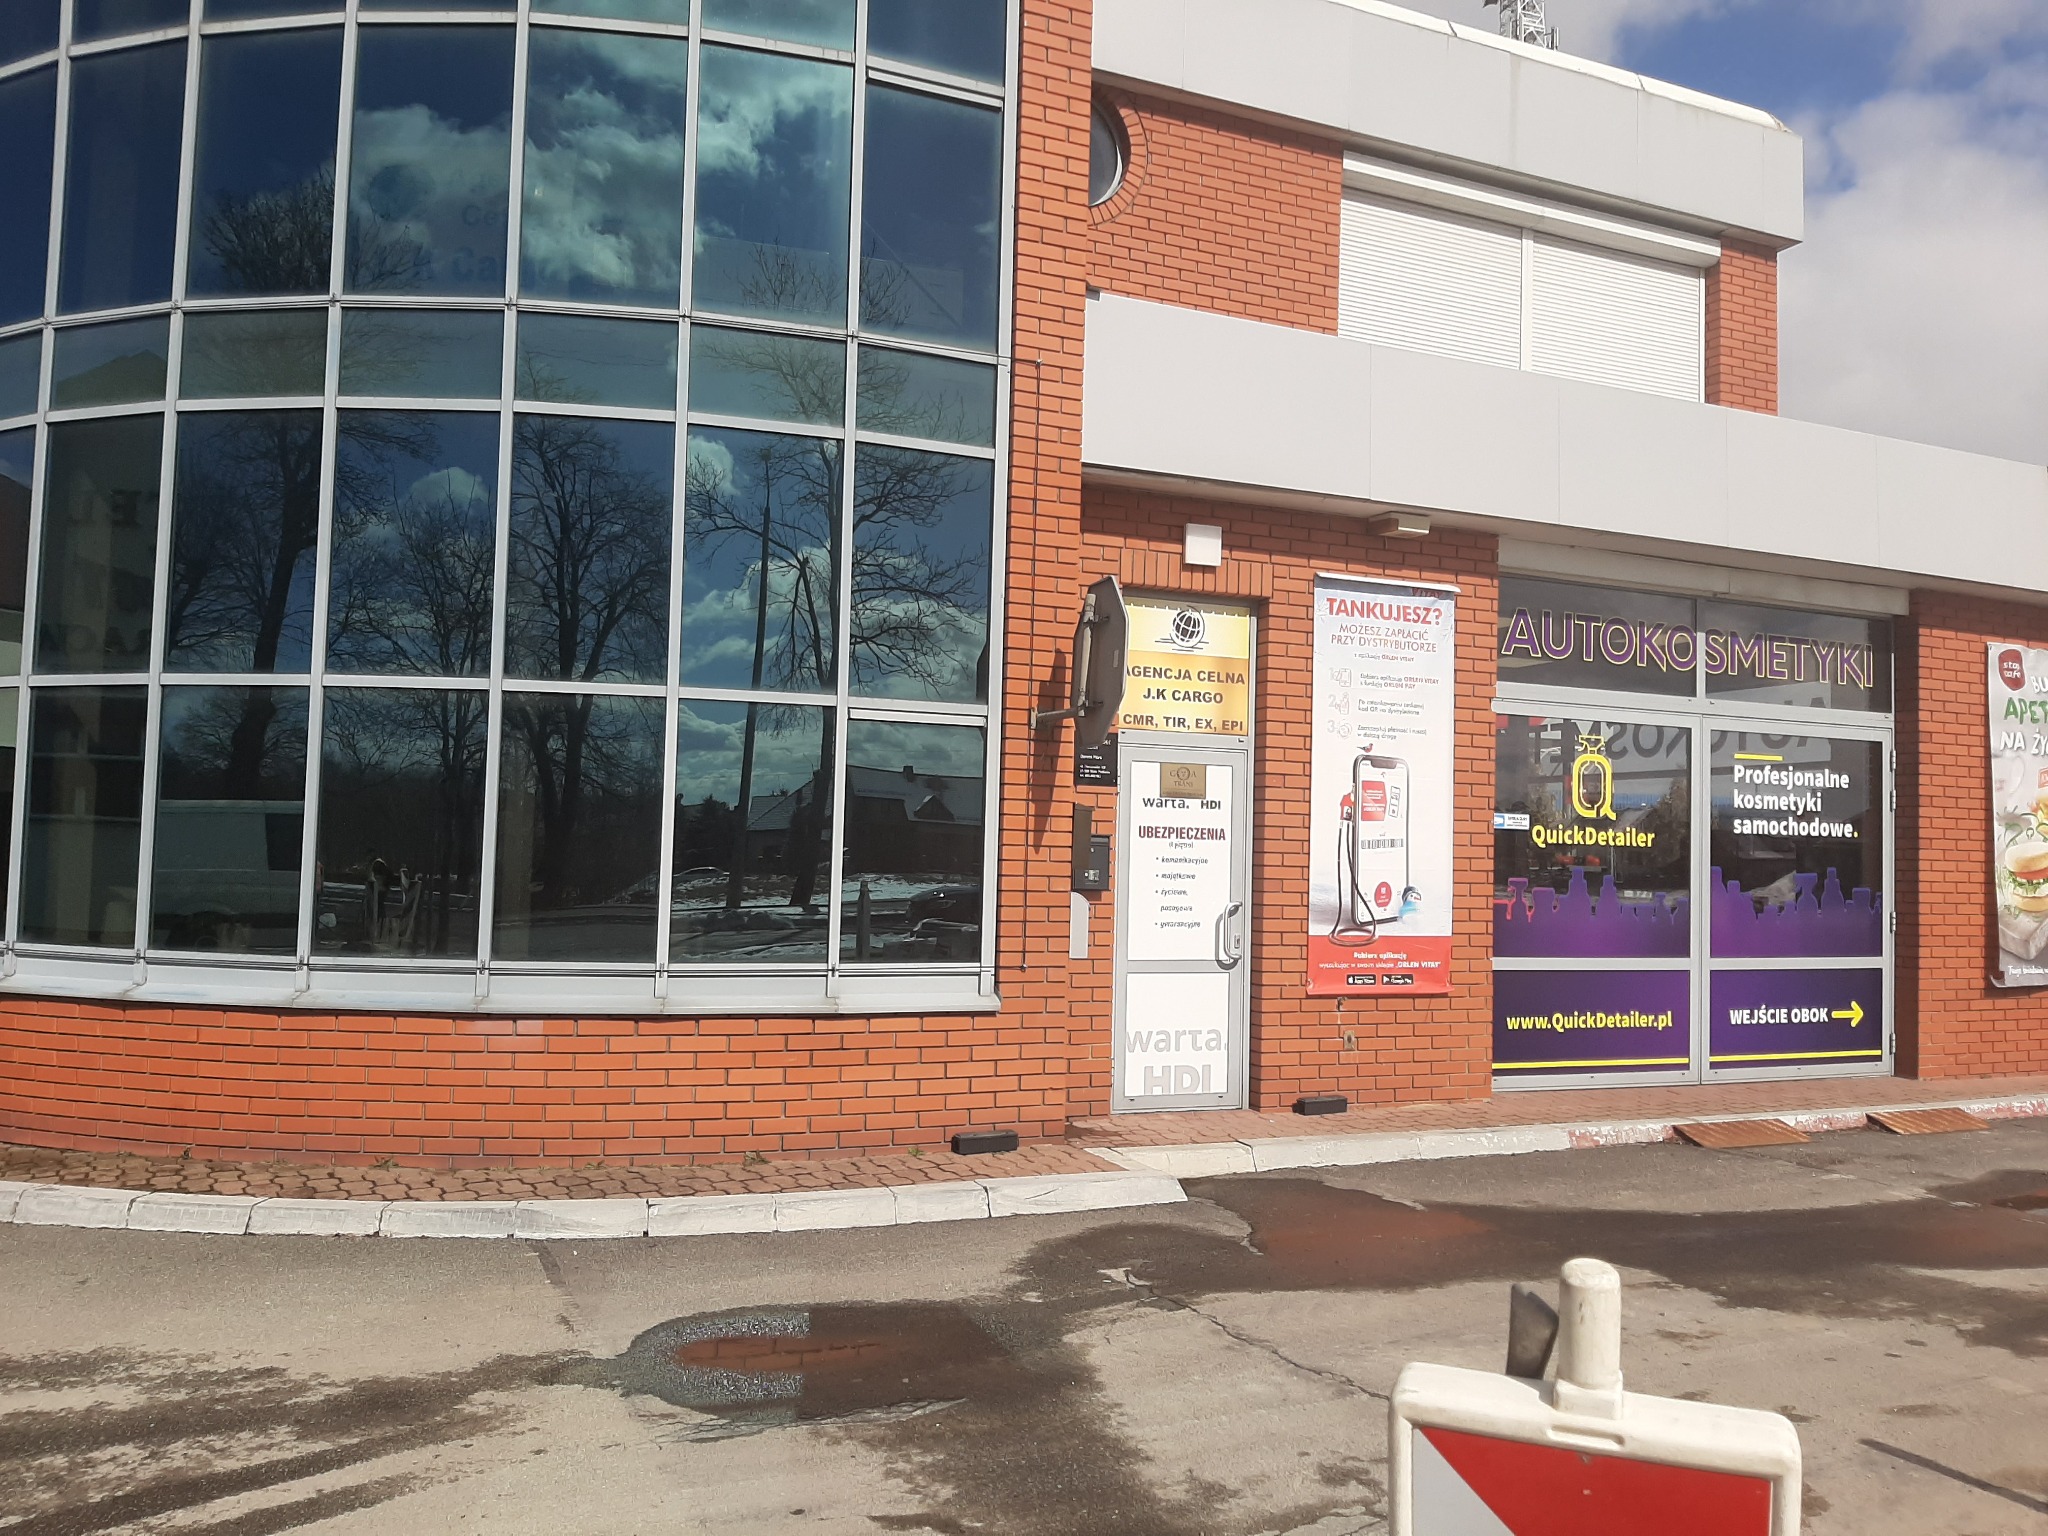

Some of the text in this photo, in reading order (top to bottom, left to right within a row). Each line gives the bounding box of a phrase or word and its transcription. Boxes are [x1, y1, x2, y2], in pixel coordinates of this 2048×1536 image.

[1326, 597, 1443, 626] TANKUJESZ?
[1339, 623, 1429, 641] MOŻESZ ZAPŁACIĆ
[1331, 634, 1437, 653] PRZY DYSTRYBUTORZE
[1501, 607, 1873, 690] AUTOKOSMETYKI
[1197, 670, 1245, 684] CELNA
[1143, 688, 1223, 704] J.K CARGO
[1123, 713, 1243, 732] CMR, TIR, EX, EPI
[2000, 731, 2025, 751] NA
[1734, 765, 1850, 790] Profesjonalne
[1200, 800, 1221, 810] HDI
[1734, 789, 1822, 815] kosmetyki
[1138, 825, 1226, 841] UBEZPIECZENIA
[1531, 824, 1655, 848] QuickDetailer
[1733, 817, 1858, 838] samochodowe.
[1506, 1010, 1673, 1032] www.QuickDetailer.pl
[1729, 1005, 1829, 1025] WEJŚCIE OBOK
[1127, 1028, 1226, 1053] warta
[1144, 1064, 1211, 1096] HDI
